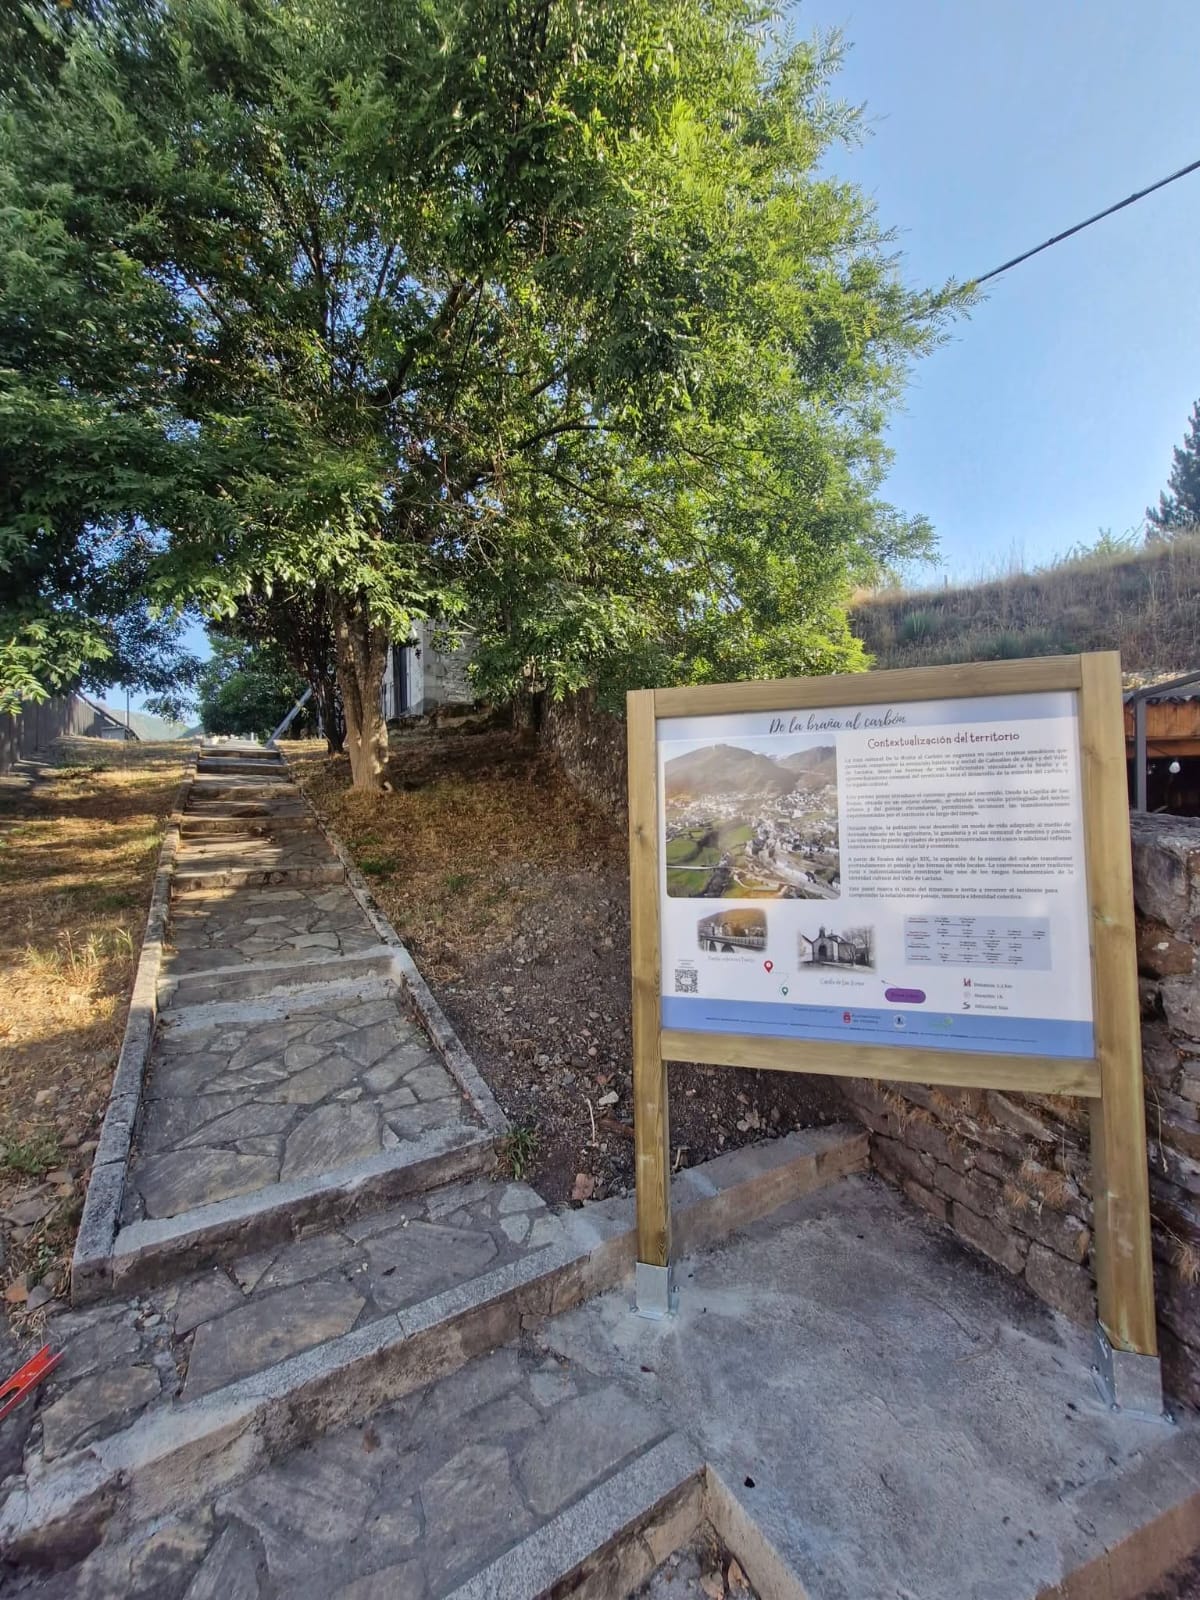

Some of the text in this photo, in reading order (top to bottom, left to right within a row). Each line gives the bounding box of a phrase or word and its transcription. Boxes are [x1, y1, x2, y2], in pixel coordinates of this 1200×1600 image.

[769, 709, 907, 734] De la braña al carbón
[867, 731, 1020, 749] Contextualización del territorio
